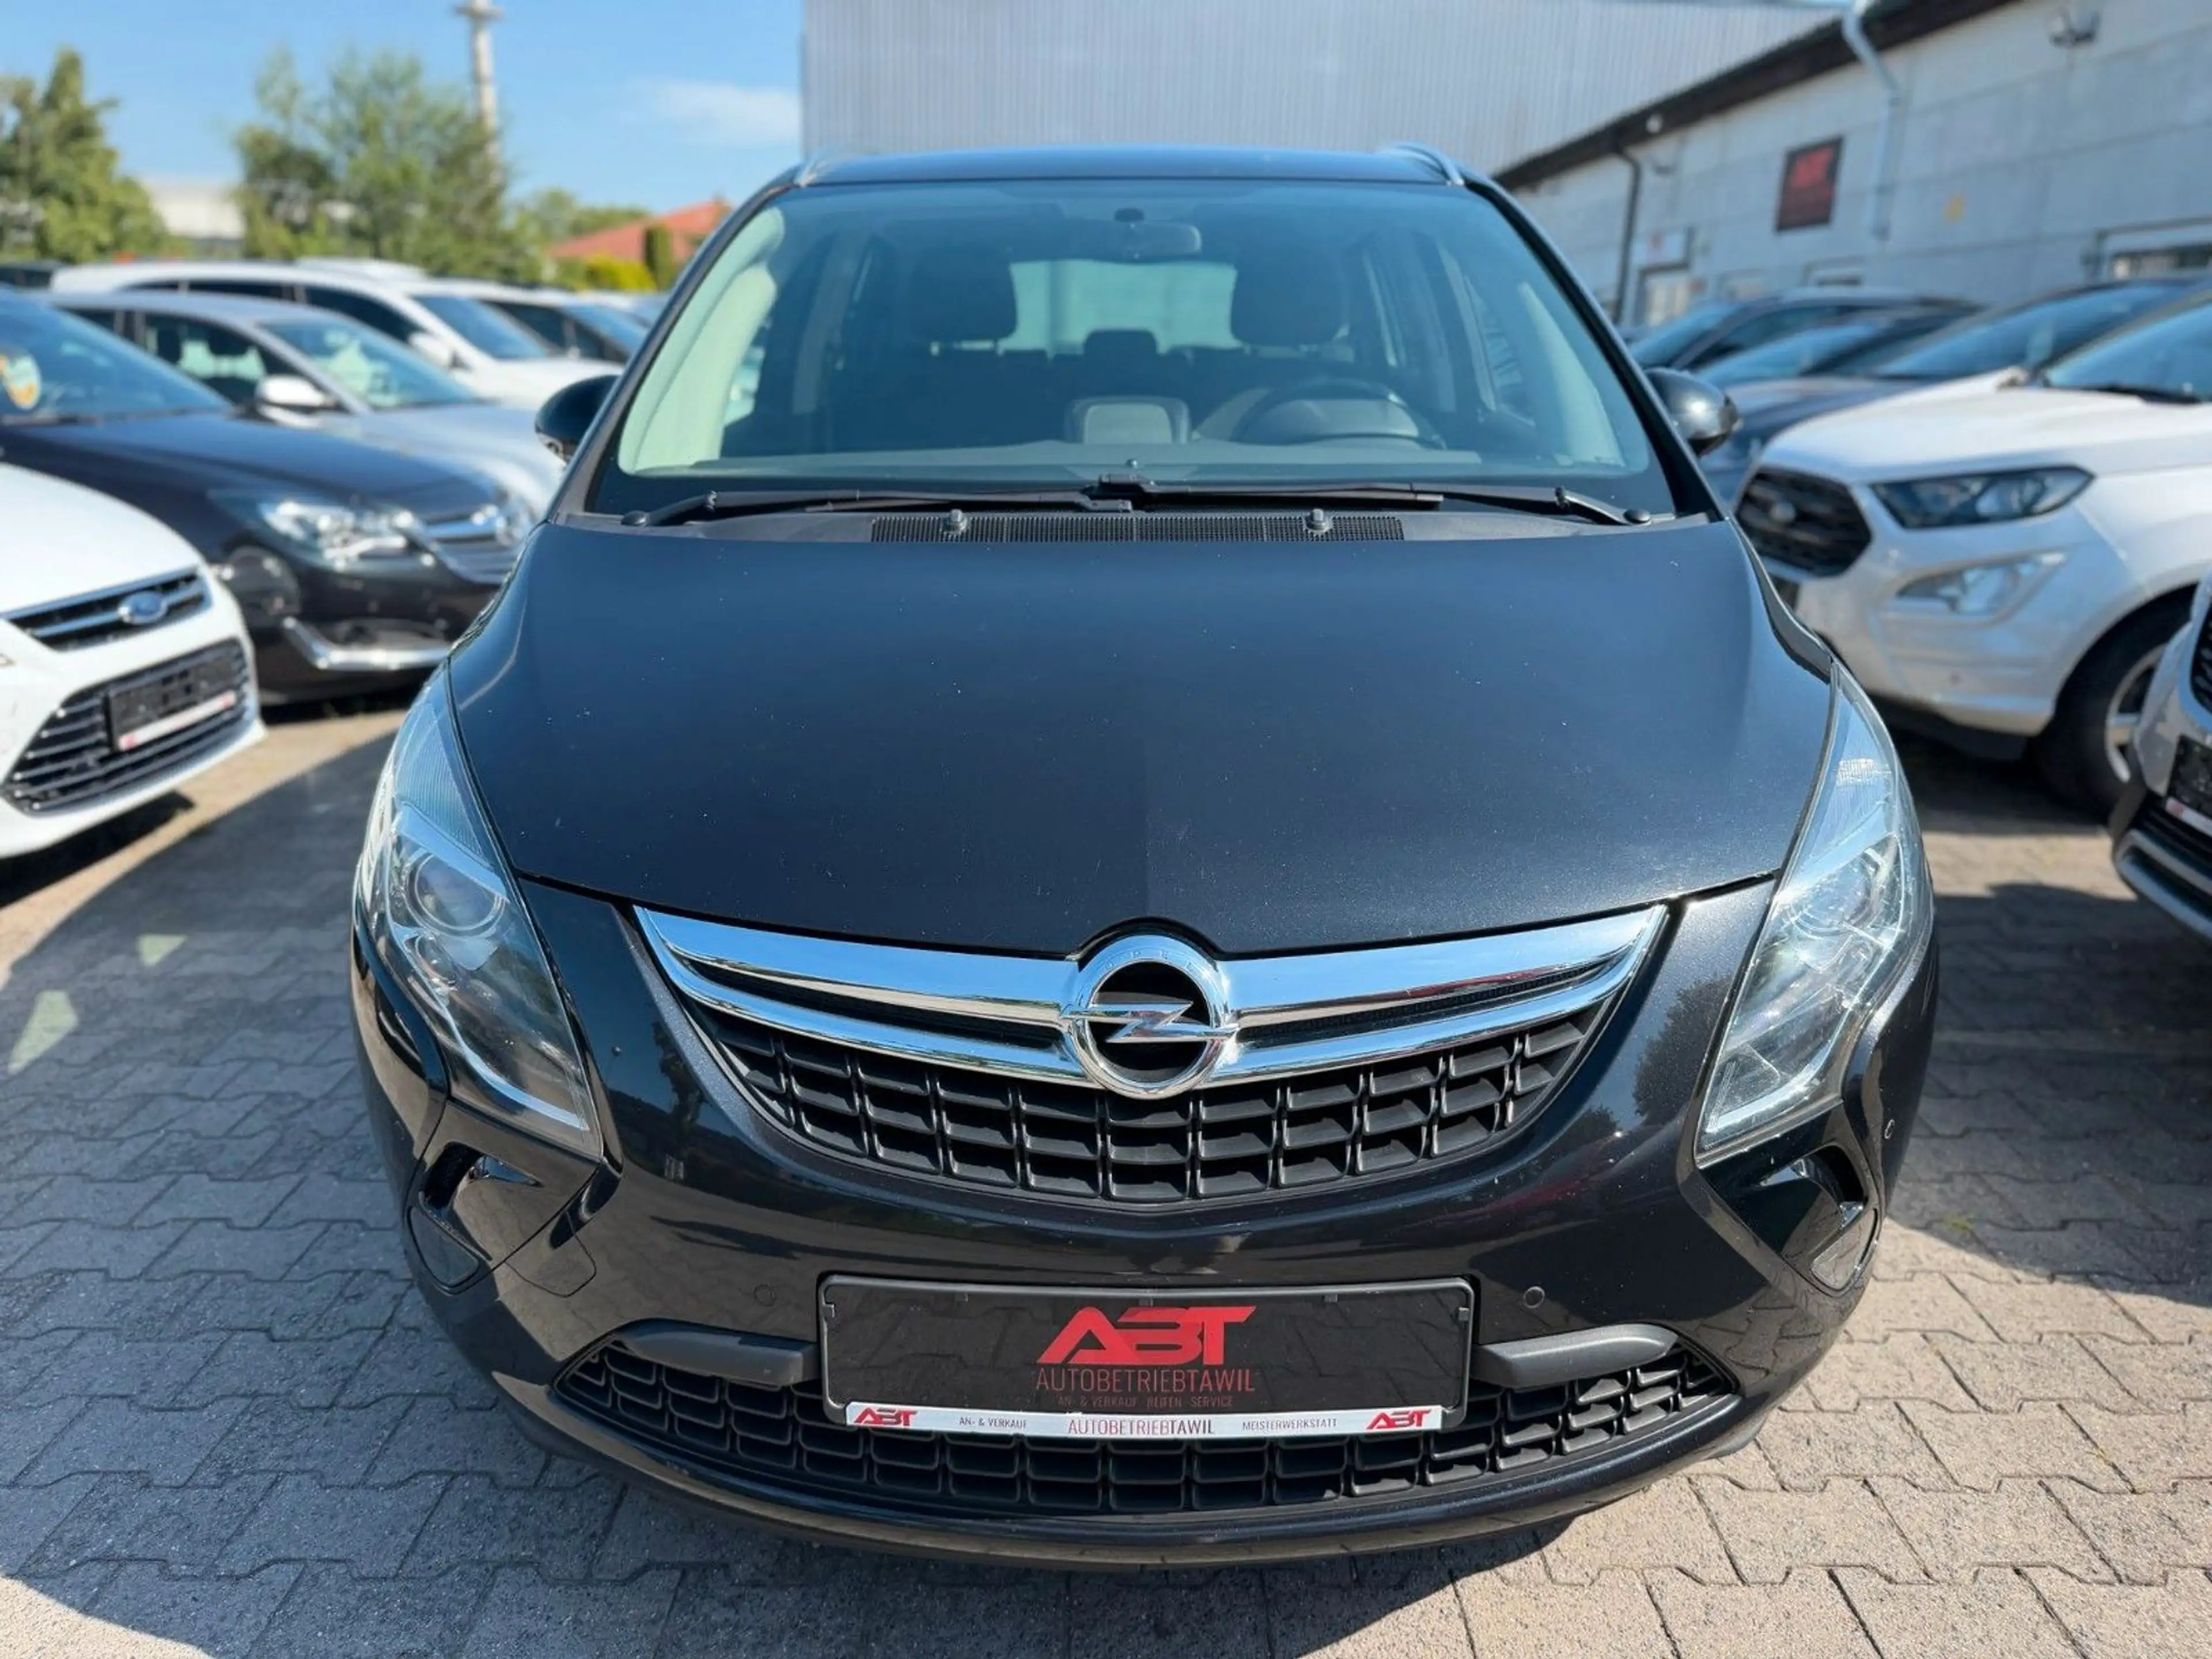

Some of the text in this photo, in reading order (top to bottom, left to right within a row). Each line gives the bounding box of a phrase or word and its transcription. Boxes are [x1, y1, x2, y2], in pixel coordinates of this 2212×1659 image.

[1036, 1305, 1256, 1365] ABT
[1036, 1367, 1256, 1393] AUTOBETRIEBTAWIL
[853, 1407, 919, 1426] ABT
[978, 1417, 985, 1427] &
[988, 1417, 1028, 1430] VERKAUF
[1242, 1418, 1338, 1431] MEISTERWERKSTATT
[1366, 1408, 1432, 1430] ABT
[1068, 1419, 1215, 1435] AUTOBETRIEBTAWIL
